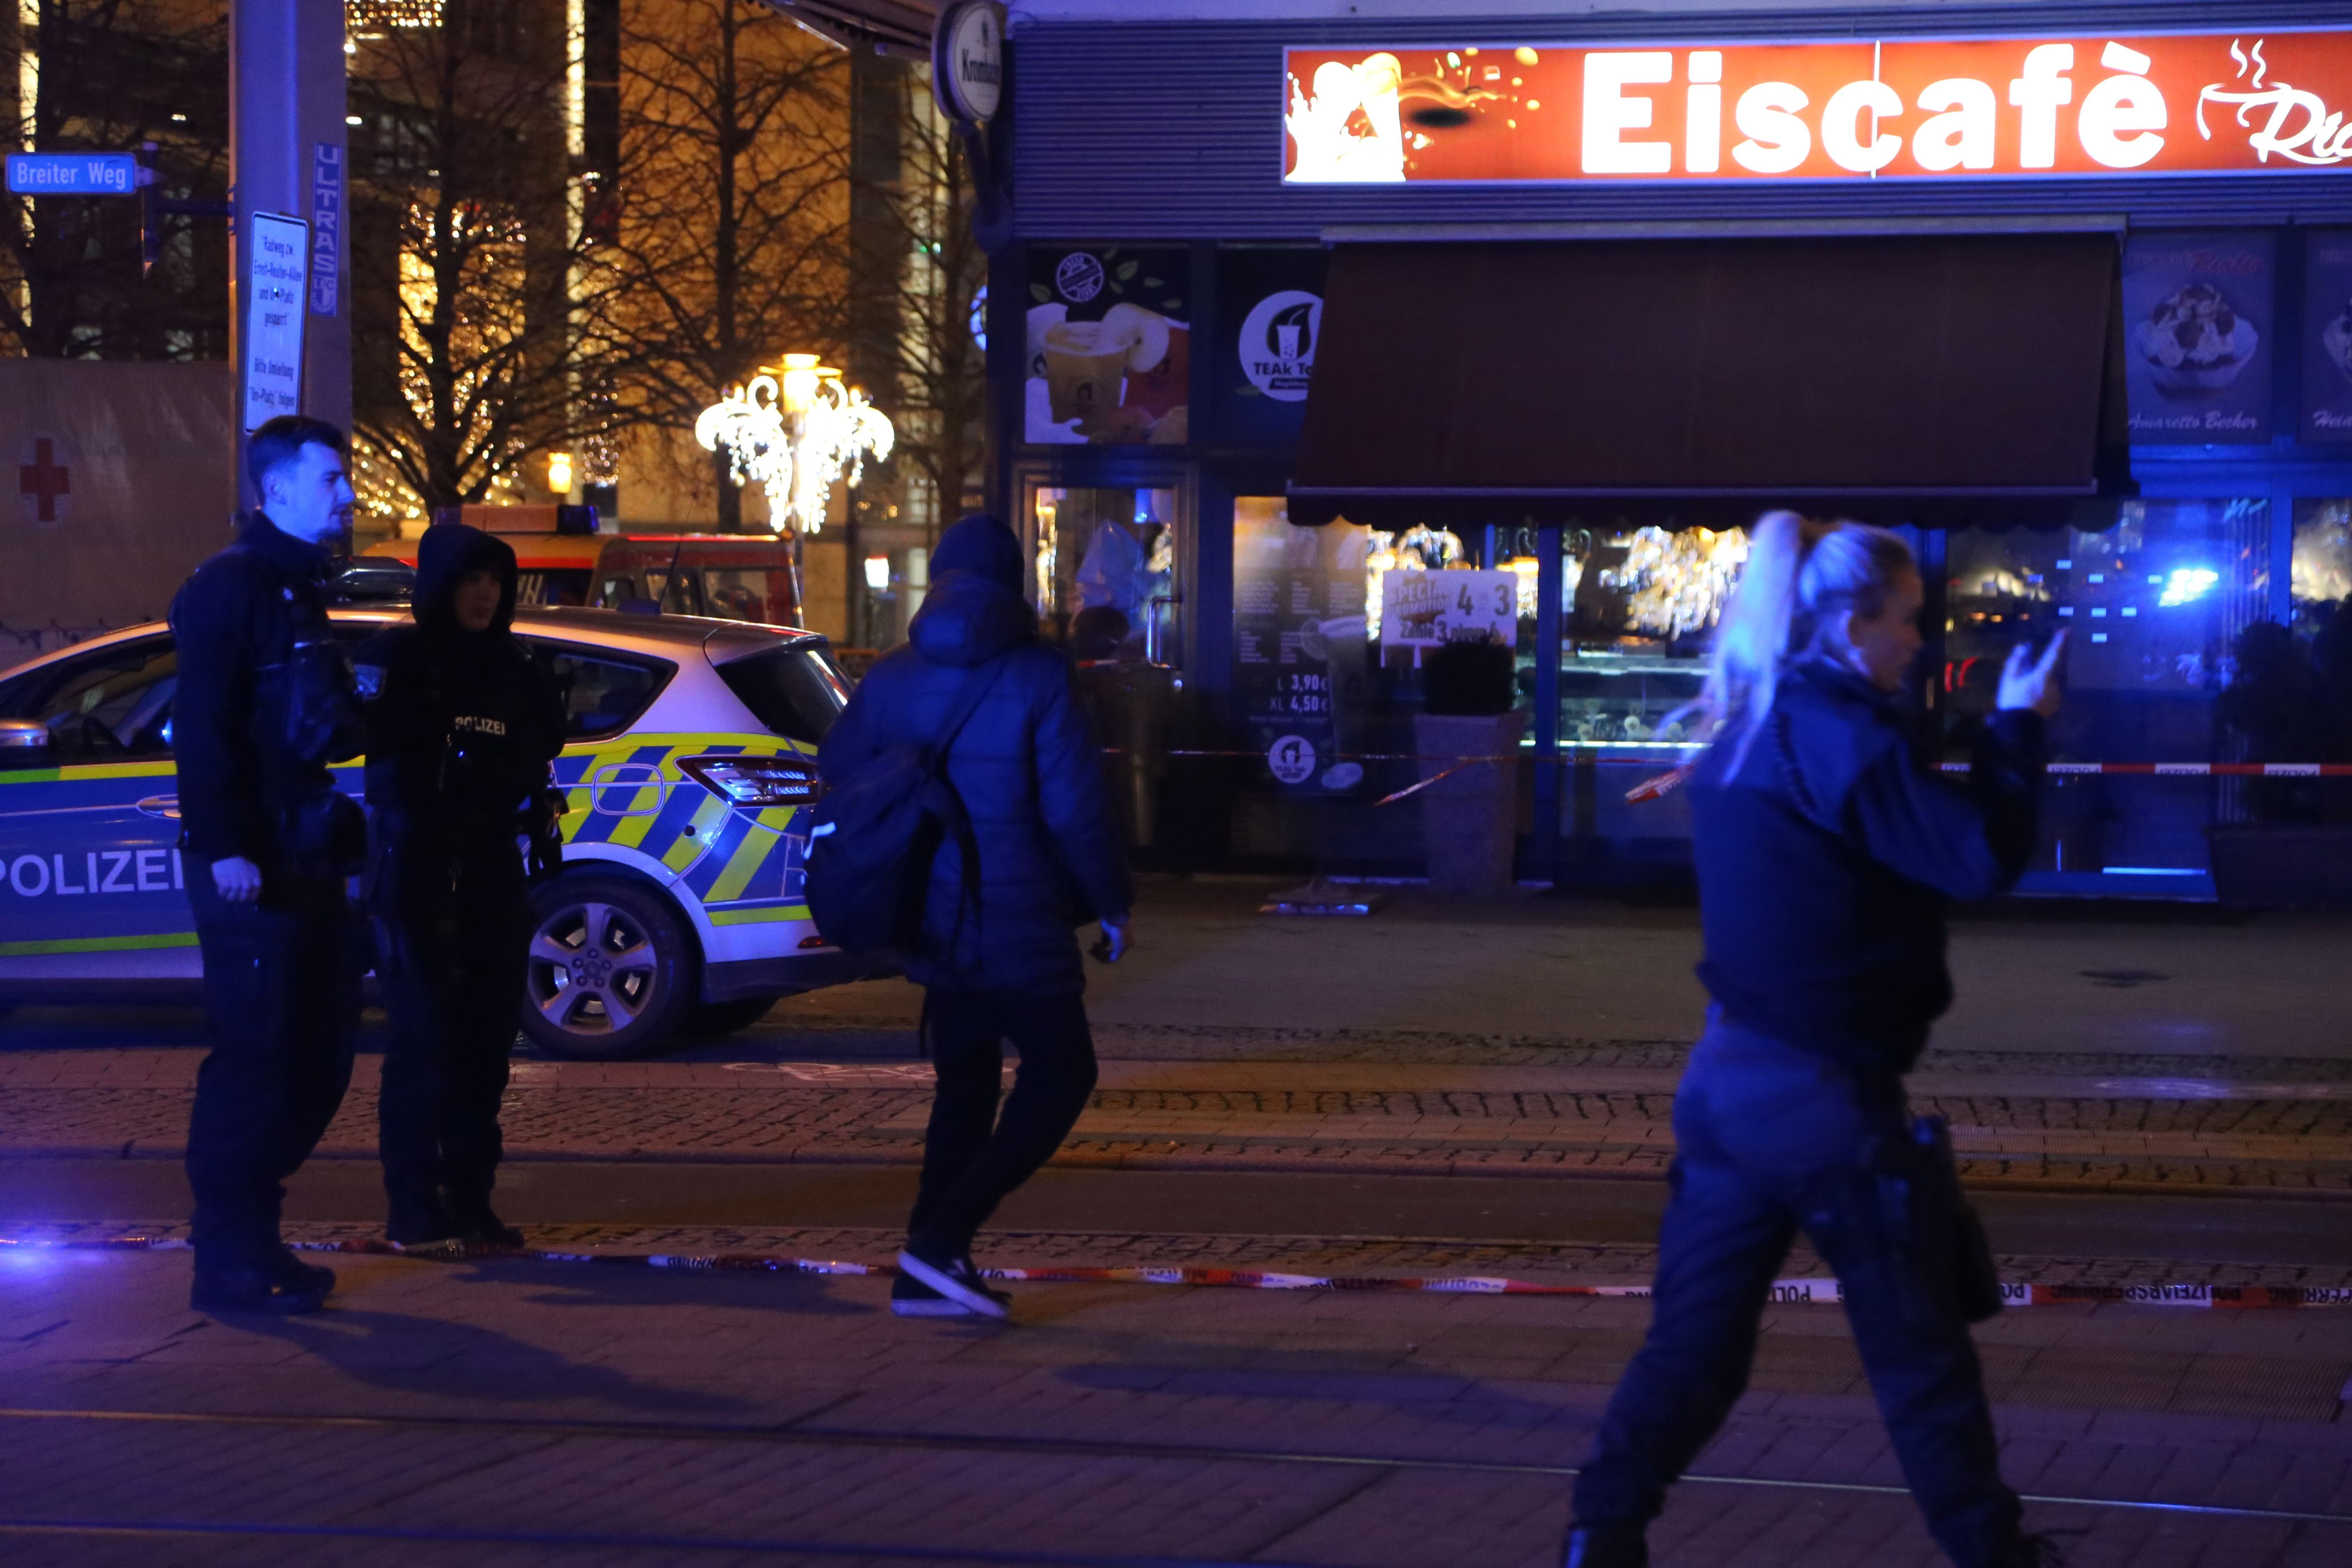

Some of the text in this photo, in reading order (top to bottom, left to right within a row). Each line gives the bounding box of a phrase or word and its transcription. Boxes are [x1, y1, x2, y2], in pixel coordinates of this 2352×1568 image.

[17, 162, 126, 190] Breiter Weg
[314, 144, 338, 274] ULTRAS
[2205, 409, 2257, 429] Becher
[1458, 584, 1474, 616] 4
[1494, 584, 1510, 617] 3
[1270, 696, 1285, 711] XL
[455, 716, 505, 735] POLIZEI
[0, 848, 184, 897] OLIZEI
